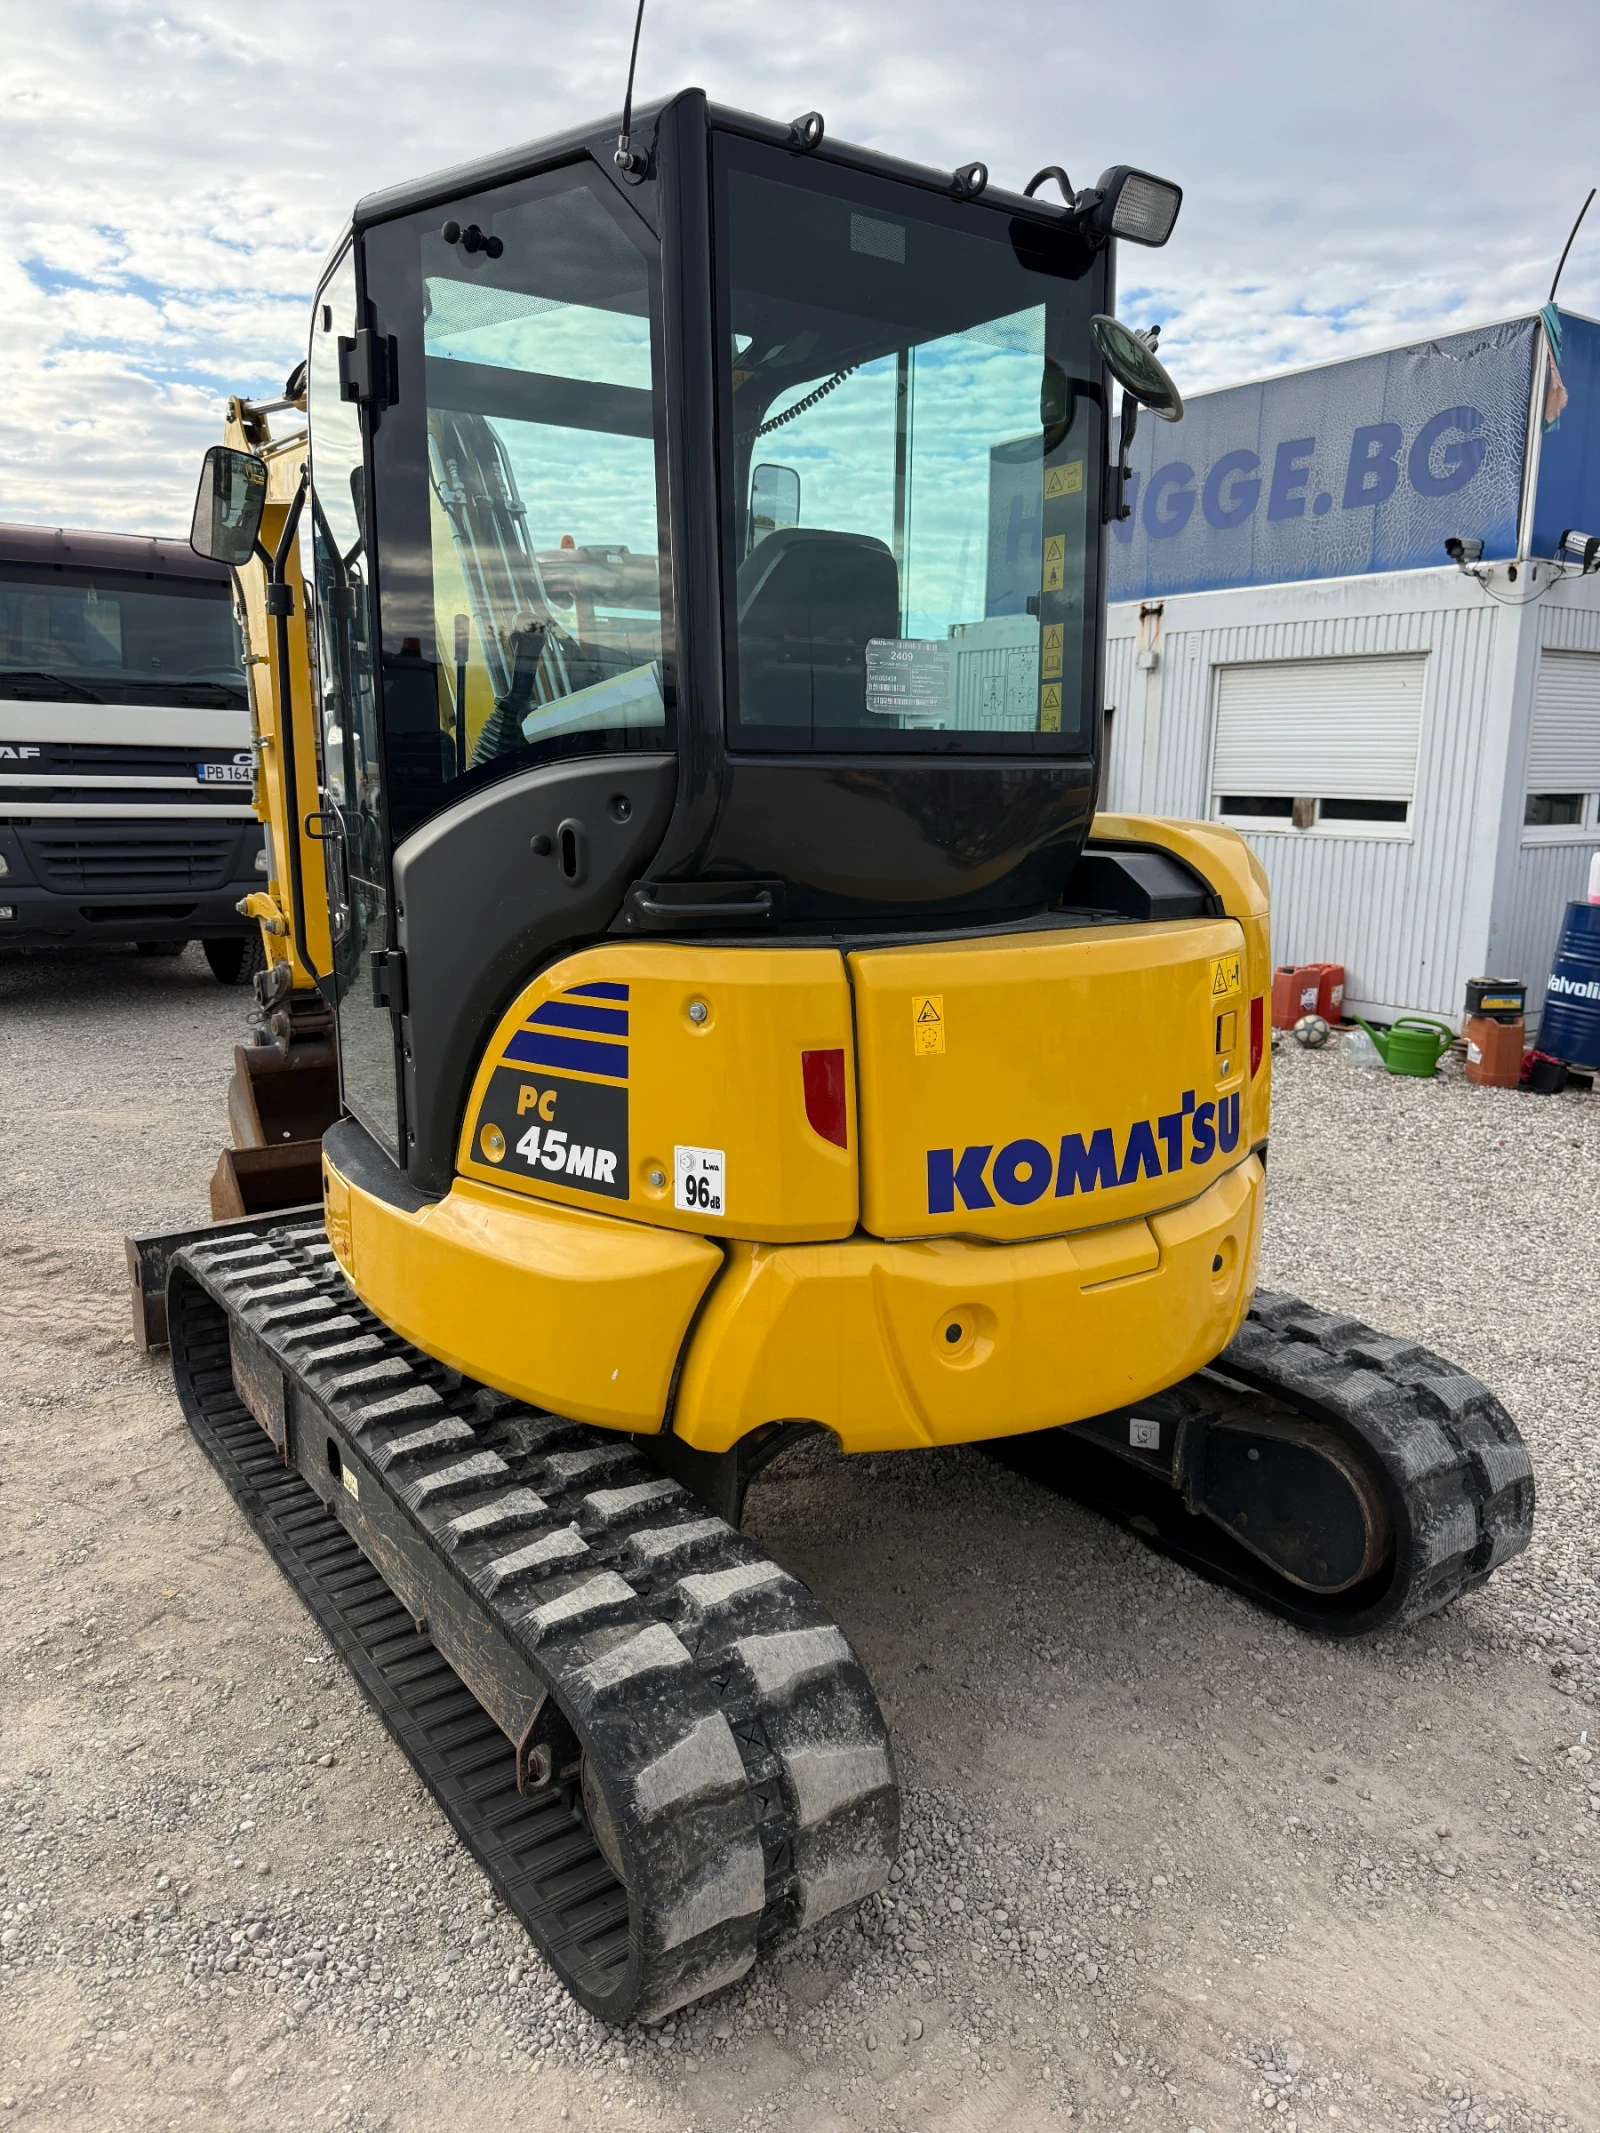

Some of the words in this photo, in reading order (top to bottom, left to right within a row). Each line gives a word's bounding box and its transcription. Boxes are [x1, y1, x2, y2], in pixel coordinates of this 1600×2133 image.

[891, 651, 914, 661] 2409
[207, 766, 224, 779] PB
[1547, 974, 1600, 1000] Valvoli
[516, 1084, 558, 1122] PC
[515, 1125, 618, 1184] 45MR
[927, 1089, 1240, 1215] KOMATSU
